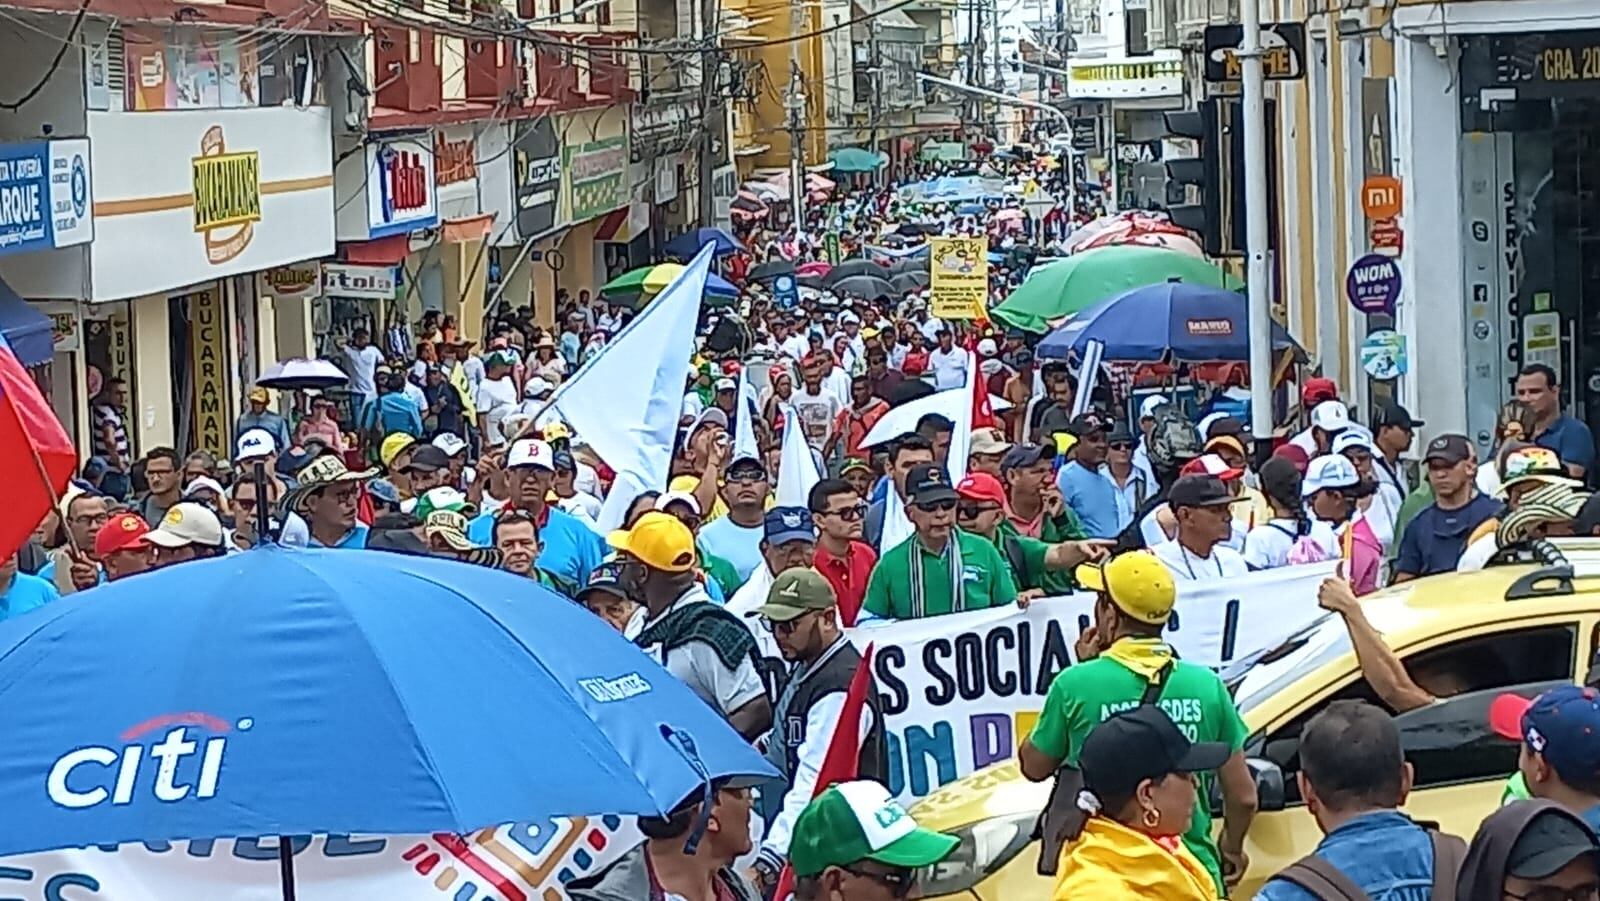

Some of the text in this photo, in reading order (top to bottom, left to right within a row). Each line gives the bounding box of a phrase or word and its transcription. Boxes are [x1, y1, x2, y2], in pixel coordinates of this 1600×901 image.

[1544, 47, 1579, 80] CRA.
[1354, 262, 1394, 285] WOM
[528, 443, 539, 457] B
[45, 727, 227, 808] citi
